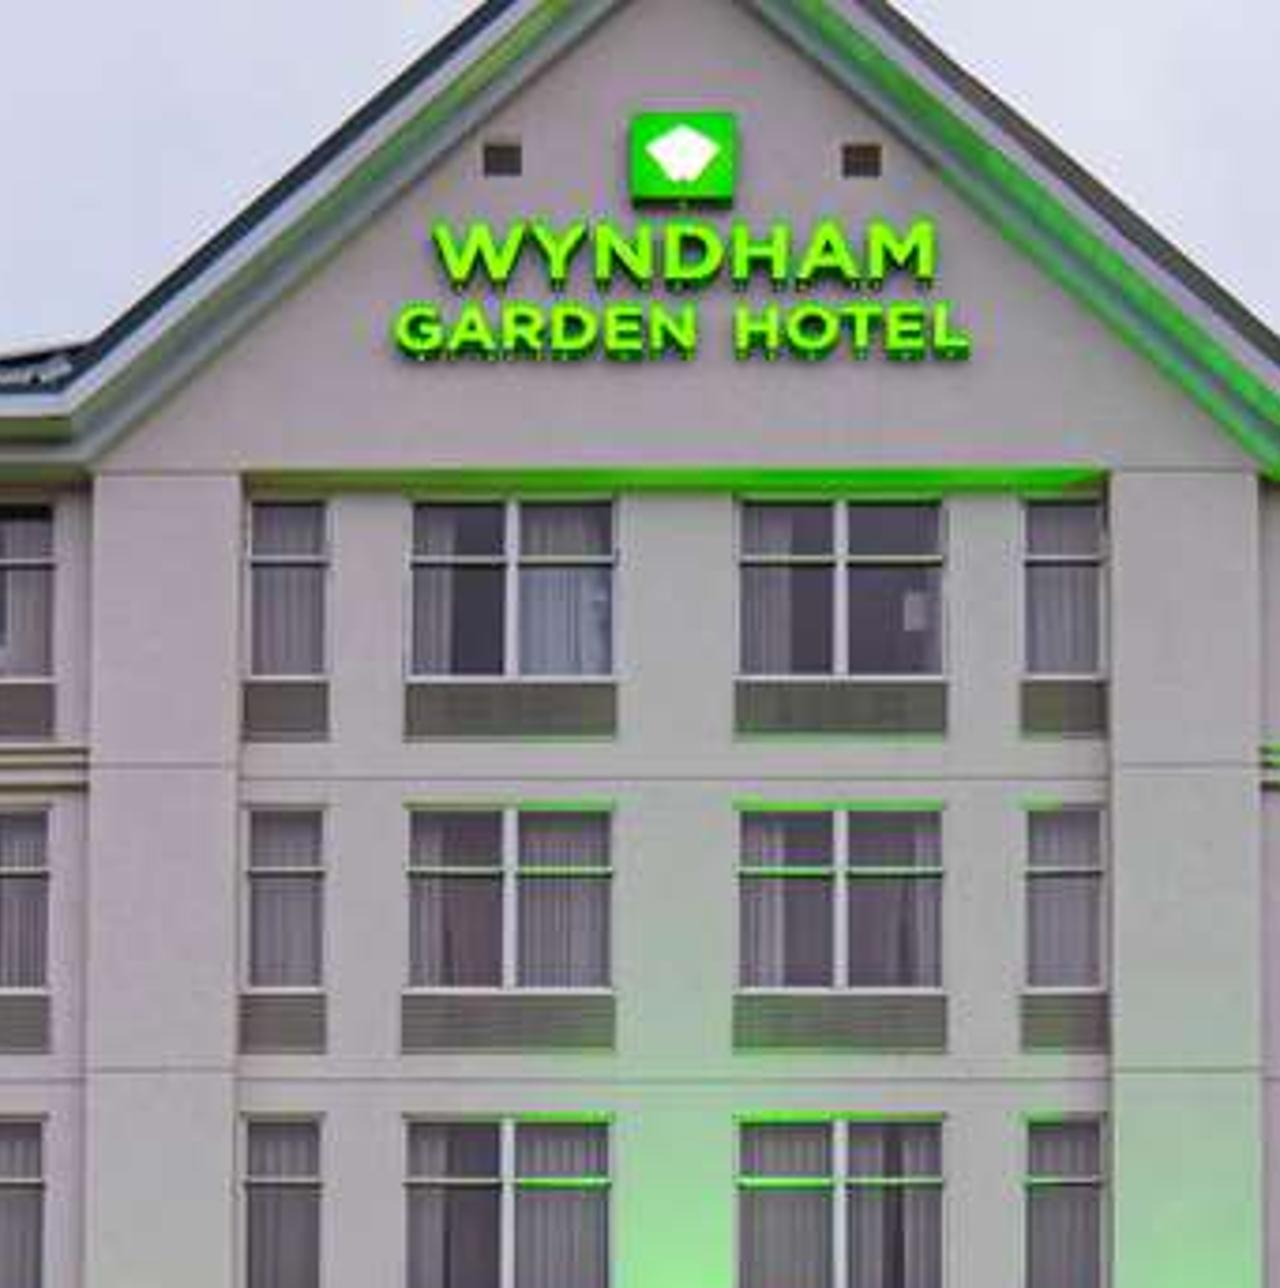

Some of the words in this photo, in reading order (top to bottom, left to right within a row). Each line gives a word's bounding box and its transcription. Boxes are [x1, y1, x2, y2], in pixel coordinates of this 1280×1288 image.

[431, 219, 937, 290] WYNDHAM
[395, 302, 697, 360] GARDEN
[734, 302, 972, 360] HOTEL
